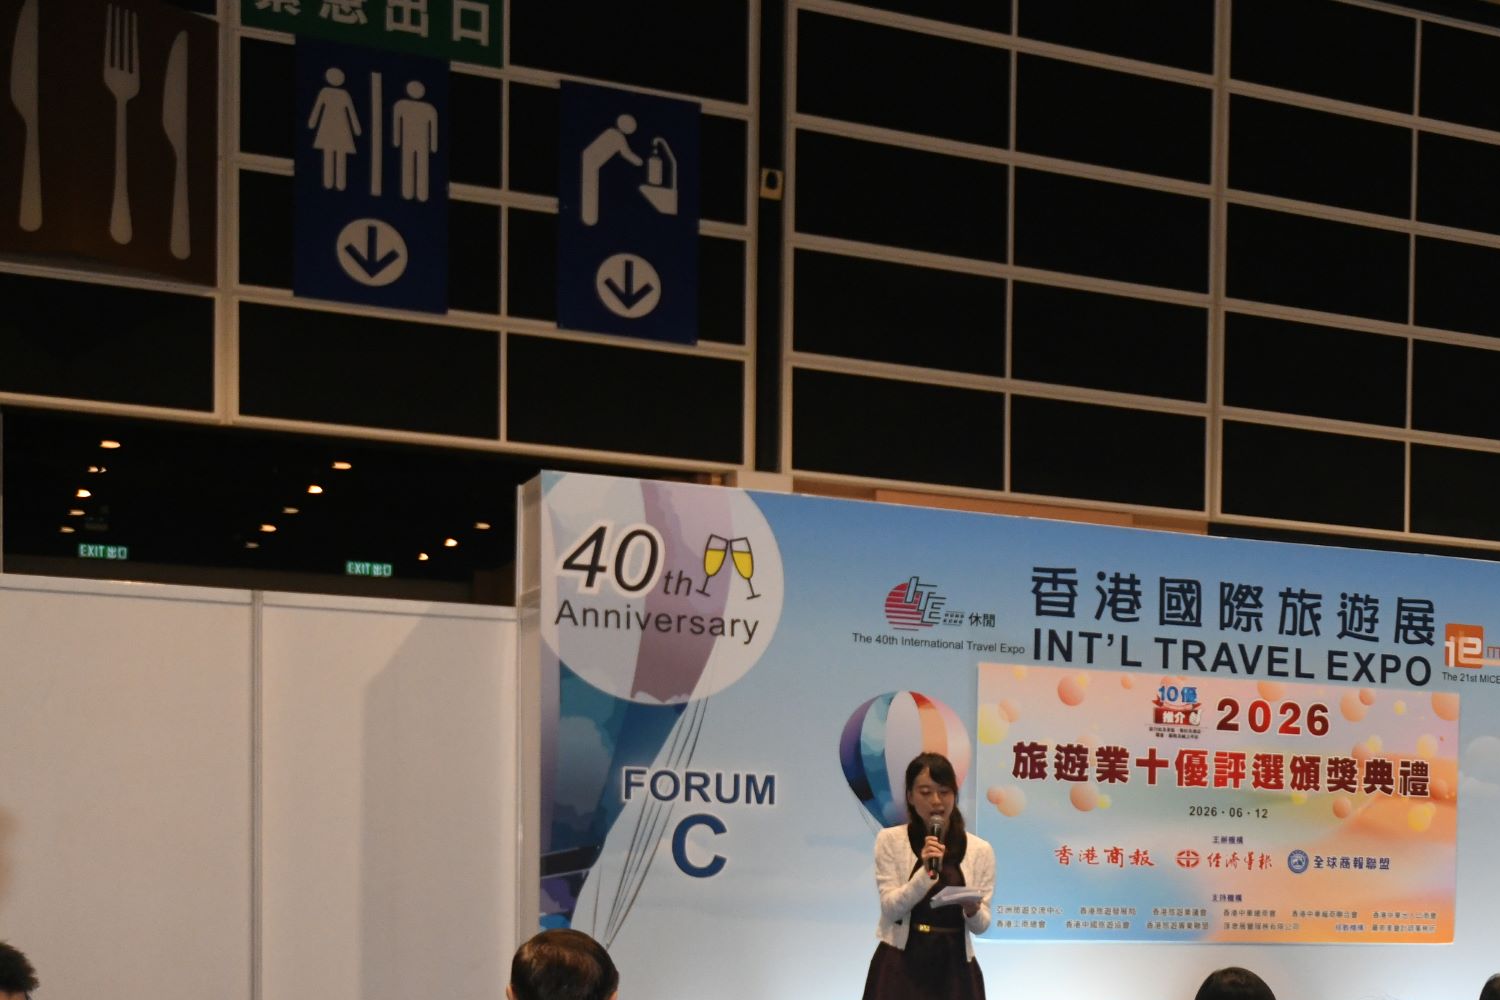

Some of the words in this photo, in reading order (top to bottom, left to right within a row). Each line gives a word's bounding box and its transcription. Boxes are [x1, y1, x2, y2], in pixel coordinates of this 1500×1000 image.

[554, 599, 759, 645] Anniversary
[1031, 566, 1437, 648] 香港國際旅遊展
[852, 632, 872, 644] The
[875, 633, 898, 646] 40th
[901, 634, 964, 650] International
[966, 640, 997, 652] Travel
[1000, 643, 1026, 655] Expo
[1033, 628, 1142, 668] INT'L
[1154, 637, 1315, 680] TRAVEL
[1327, 650, 1432, 687] EXPO
[1442, 672, 1458, 682] The
[1460, 673, 1478, 683] 21st
[1216, 698, 1329, 736] 2026
[624, 768, 775, 805] FORUM
[1012, 741, 1429, 796] 旅遊業十優評選頒獎典禮
[672, 813, 727, 878] C
[1055, 845, 1154, 868] 香港商報
[1313, 855, 1390, 870] 全球商報聯盟
